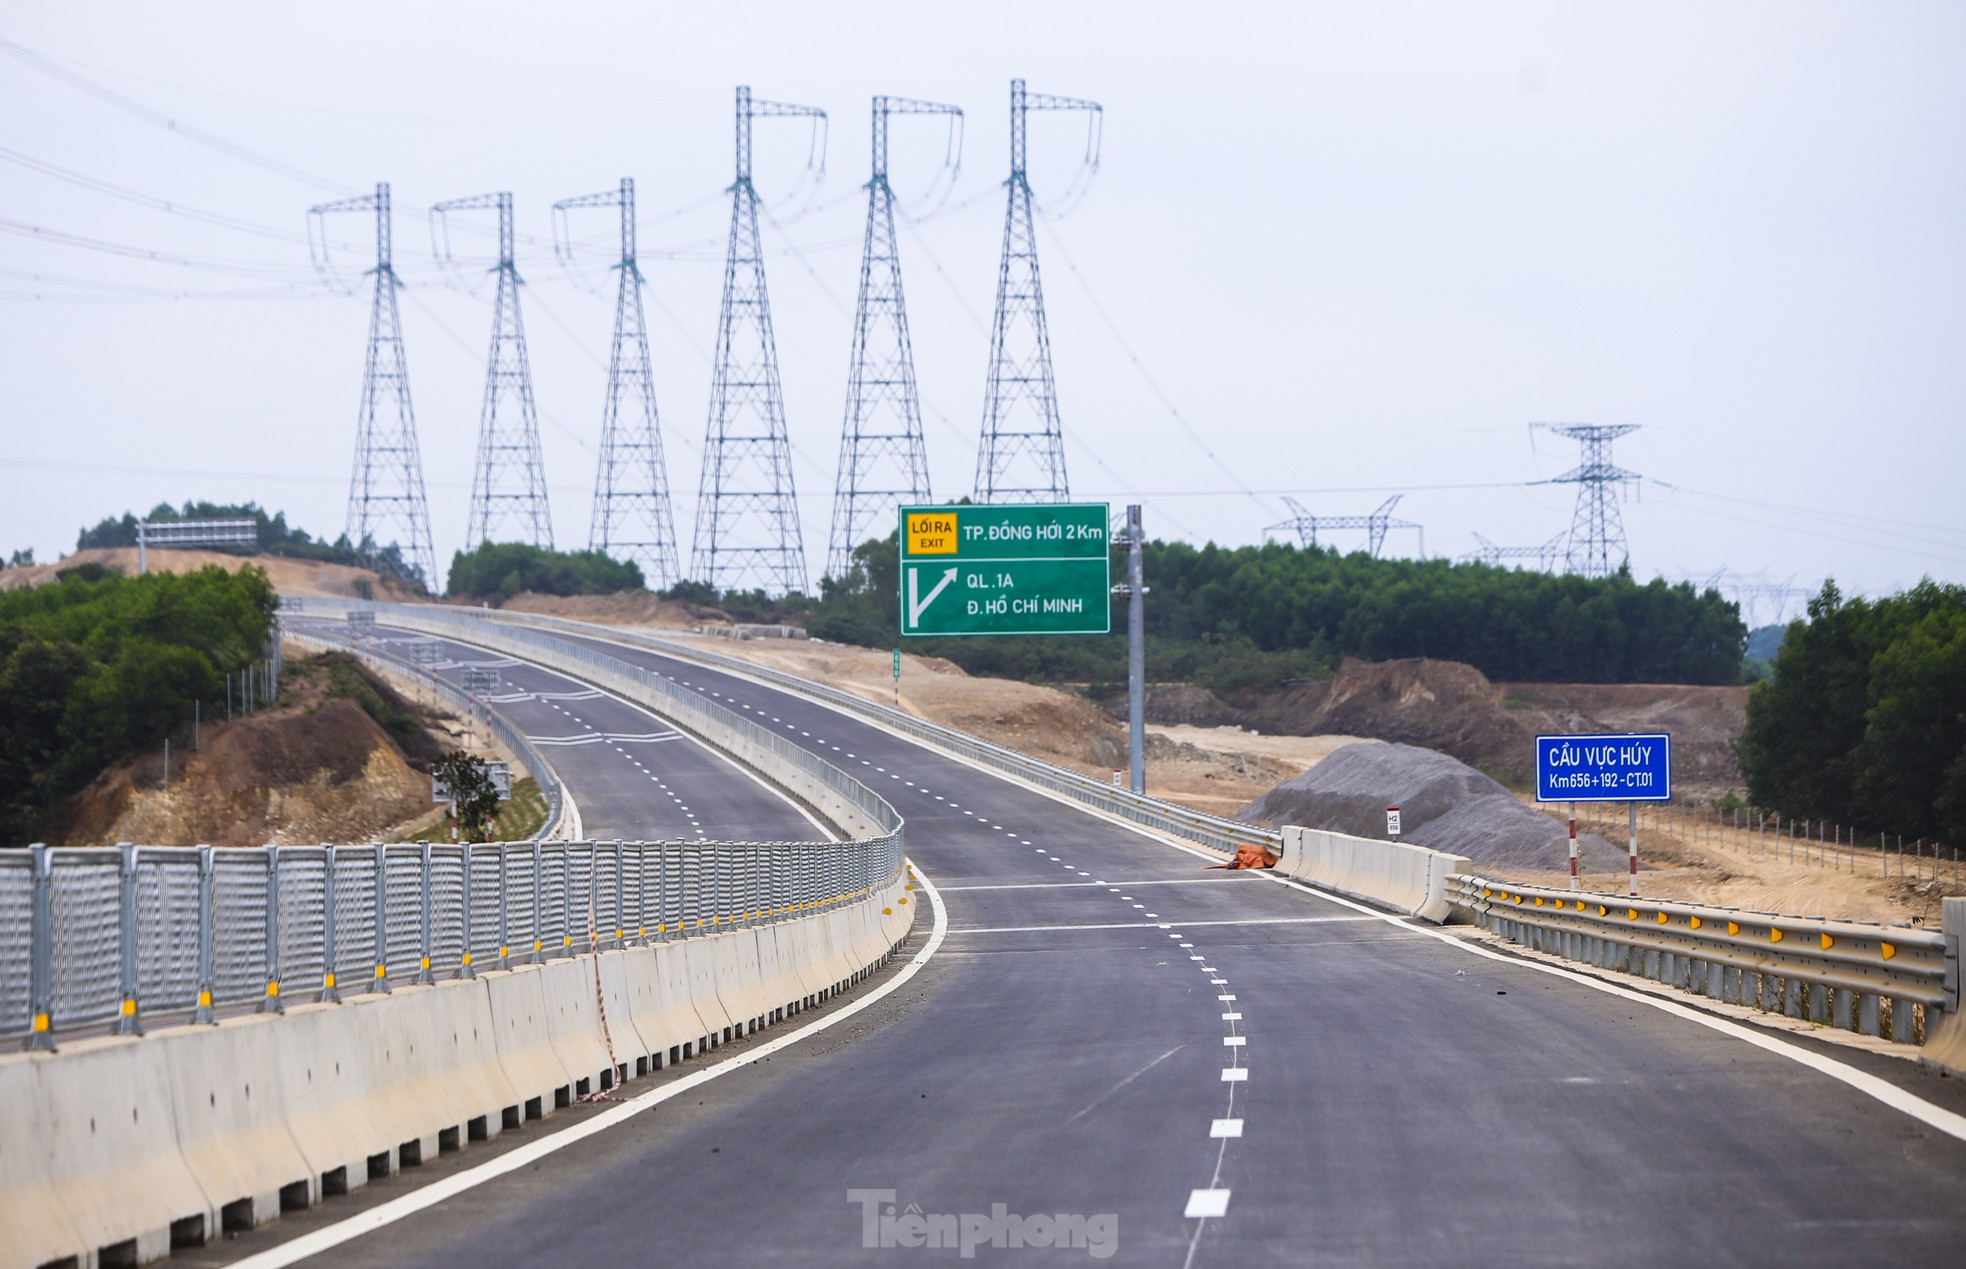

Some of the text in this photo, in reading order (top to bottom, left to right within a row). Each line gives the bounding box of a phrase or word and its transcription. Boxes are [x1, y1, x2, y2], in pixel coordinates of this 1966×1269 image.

[912, 517, 952, 533] LỐI RA
[1036, 520, 1062, 539] HỚI
[921, 538, 944, 548] EXIT
[1012, 594, 1039, 613] CHÍ
[1043, 598, 1083, 613] MINH
[1549, 742, 1652, 770] CẦU VỰC HÚY
